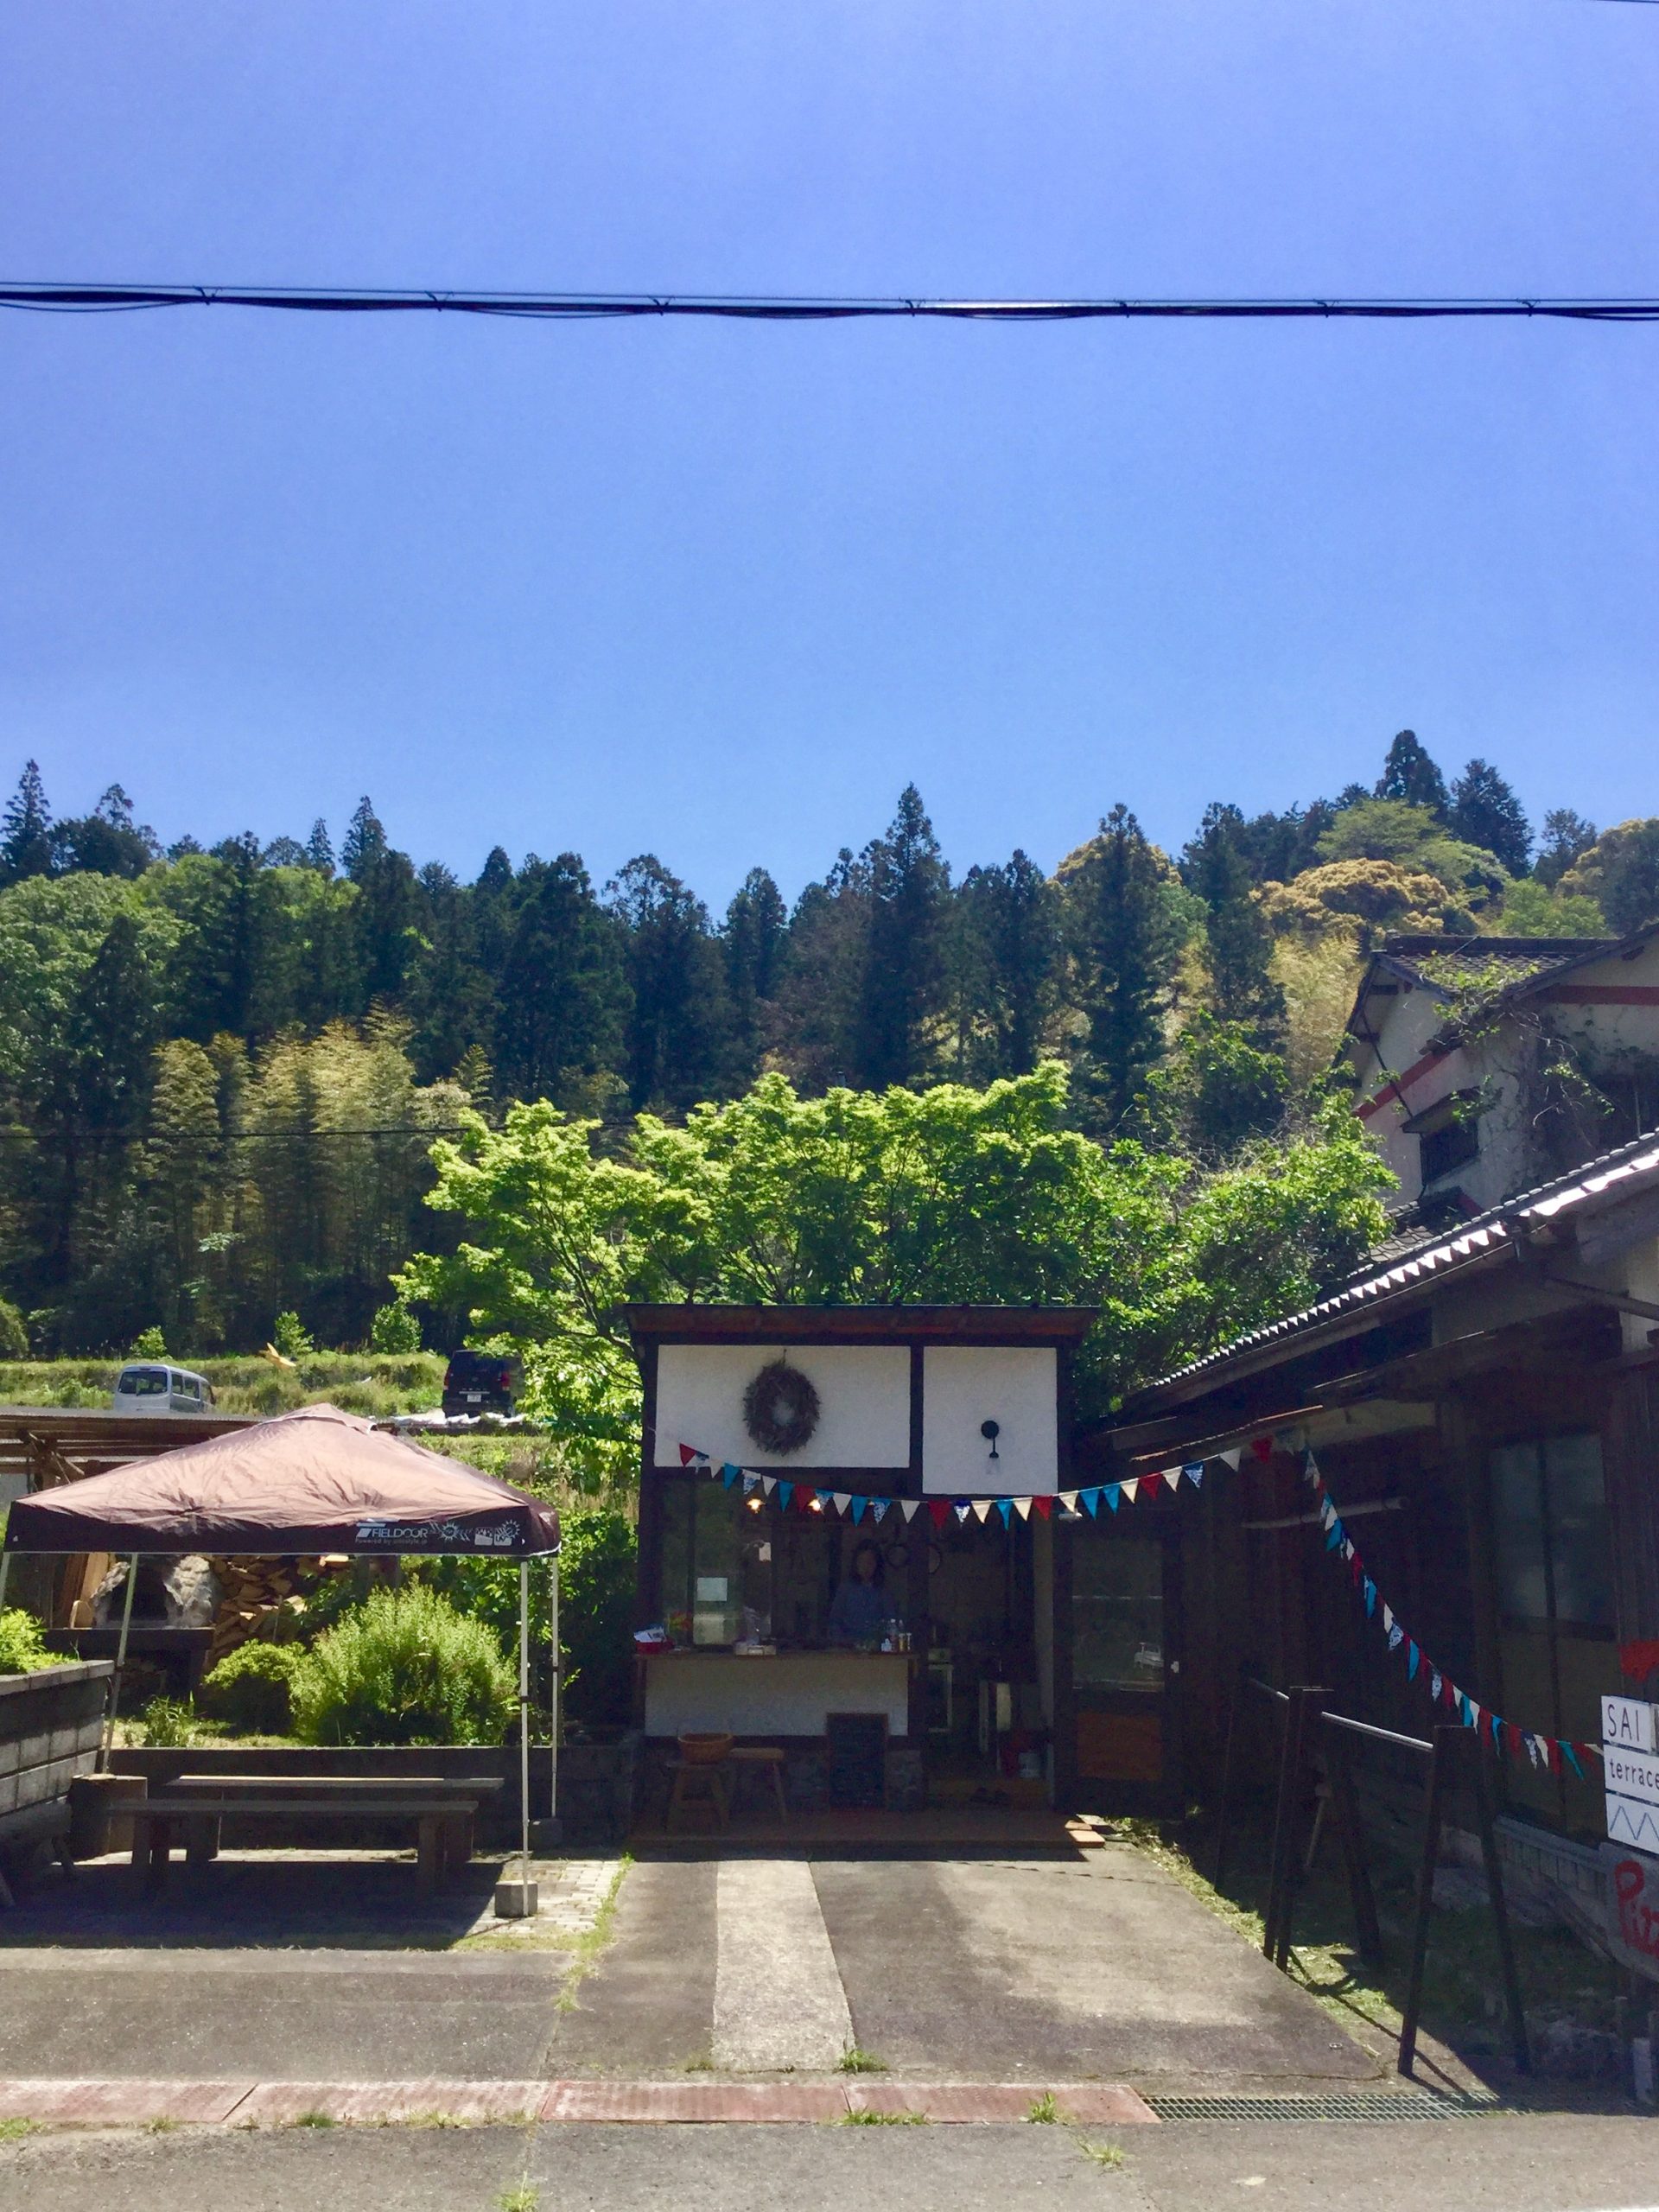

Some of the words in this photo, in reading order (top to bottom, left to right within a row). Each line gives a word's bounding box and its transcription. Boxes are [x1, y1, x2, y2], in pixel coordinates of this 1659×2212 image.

[372, 1527, 429, 1539] FIELDOOR
[1607, 1703, 1640, 1742] SAI
[1610, 1758, 1659, 1791] terrace
